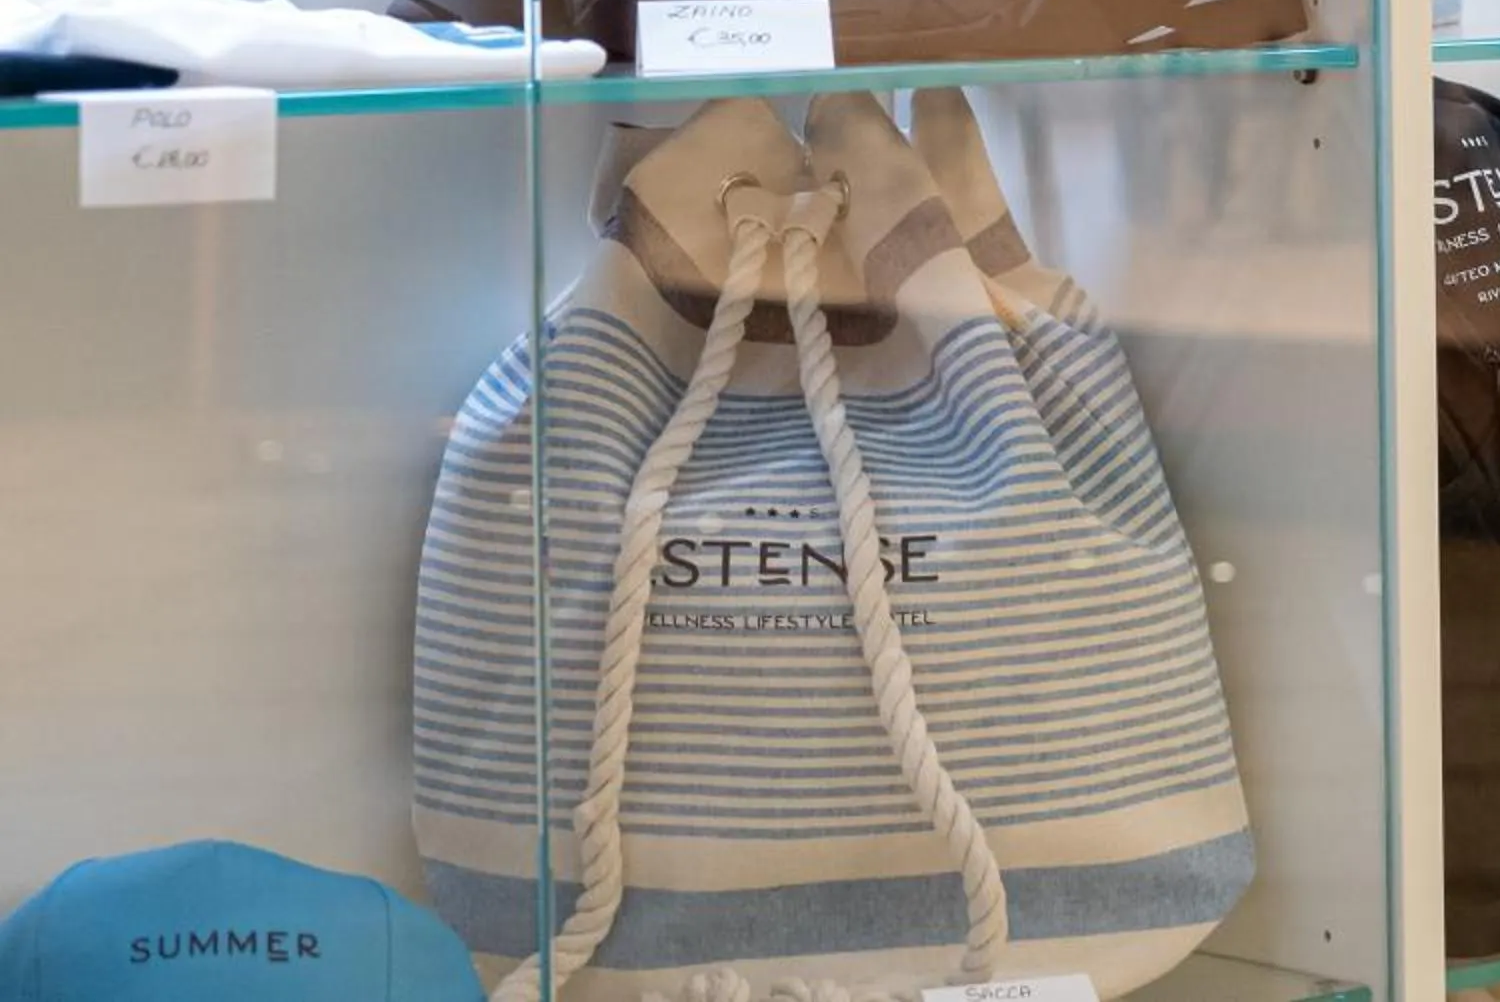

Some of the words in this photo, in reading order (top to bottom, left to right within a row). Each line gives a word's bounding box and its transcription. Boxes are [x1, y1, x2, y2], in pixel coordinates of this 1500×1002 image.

[668, 4, 753, 20] ZAINO
[649, 612, 735, 630] ELLNESS
[743, 613, 853, 630] LIFESTYLE
[890, 609, 936, 627] TEL
[130, 929, 321, 964] SUMMER
